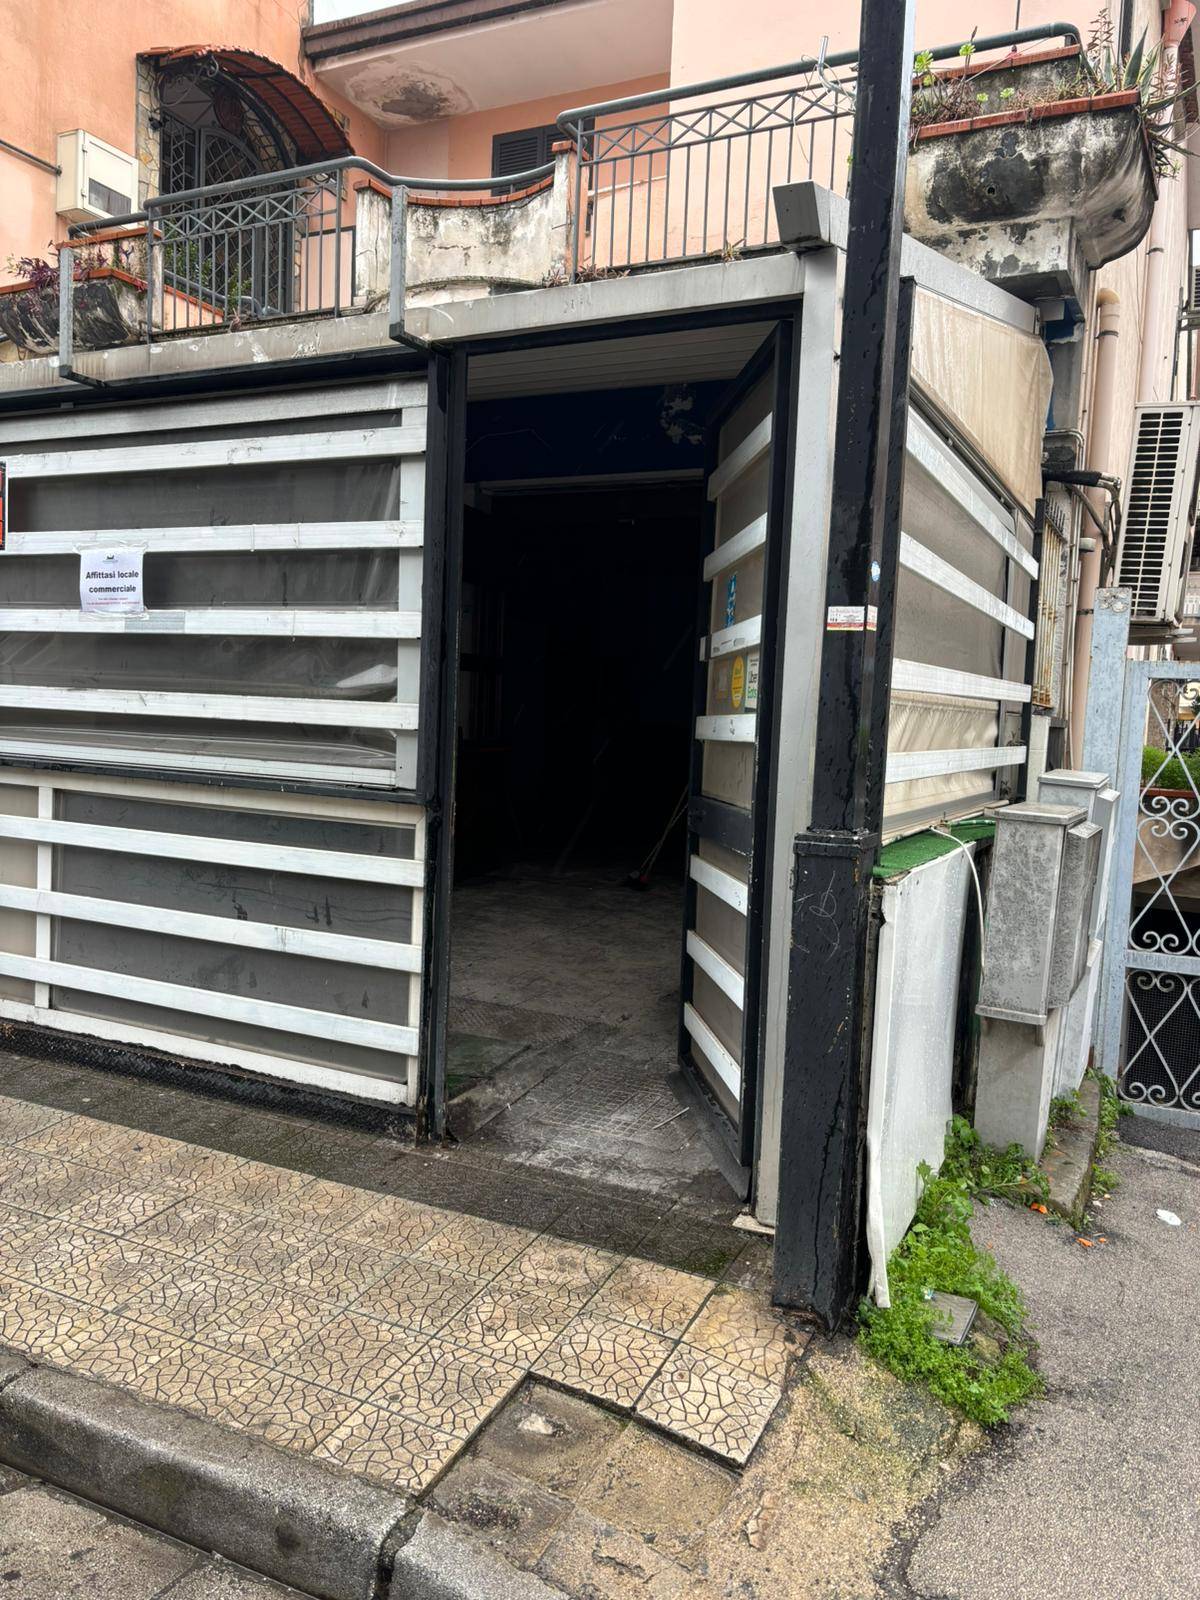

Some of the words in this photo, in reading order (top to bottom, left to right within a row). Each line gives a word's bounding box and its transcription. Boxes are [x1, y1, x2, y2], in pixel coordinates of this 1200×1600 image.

[86, 571, 116, 579] Affittasi
[118, 570, 139, 579] locale
[89, 585, 136, 593] commerciale
